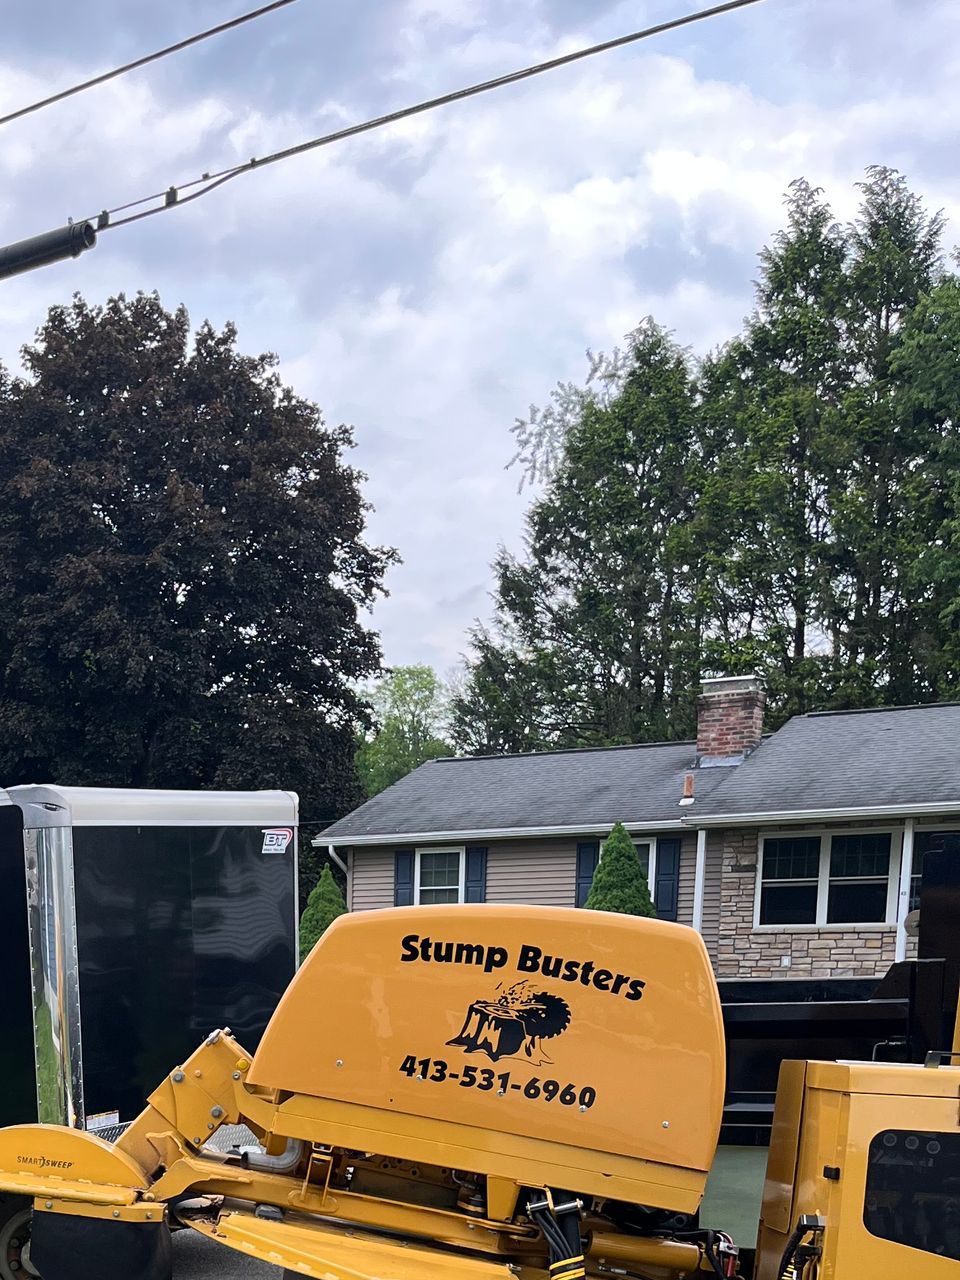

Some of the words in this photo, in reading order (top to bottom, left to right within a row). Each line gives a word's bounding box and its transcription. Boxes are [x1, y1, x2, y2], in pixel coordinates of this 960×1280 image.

[265, 833, 287, 846] BT
[400, 934, 509, 973] Stump
[516, 944, 646, 1001] Busters
[399, 1055, 597, 1109] 413-531-6960
